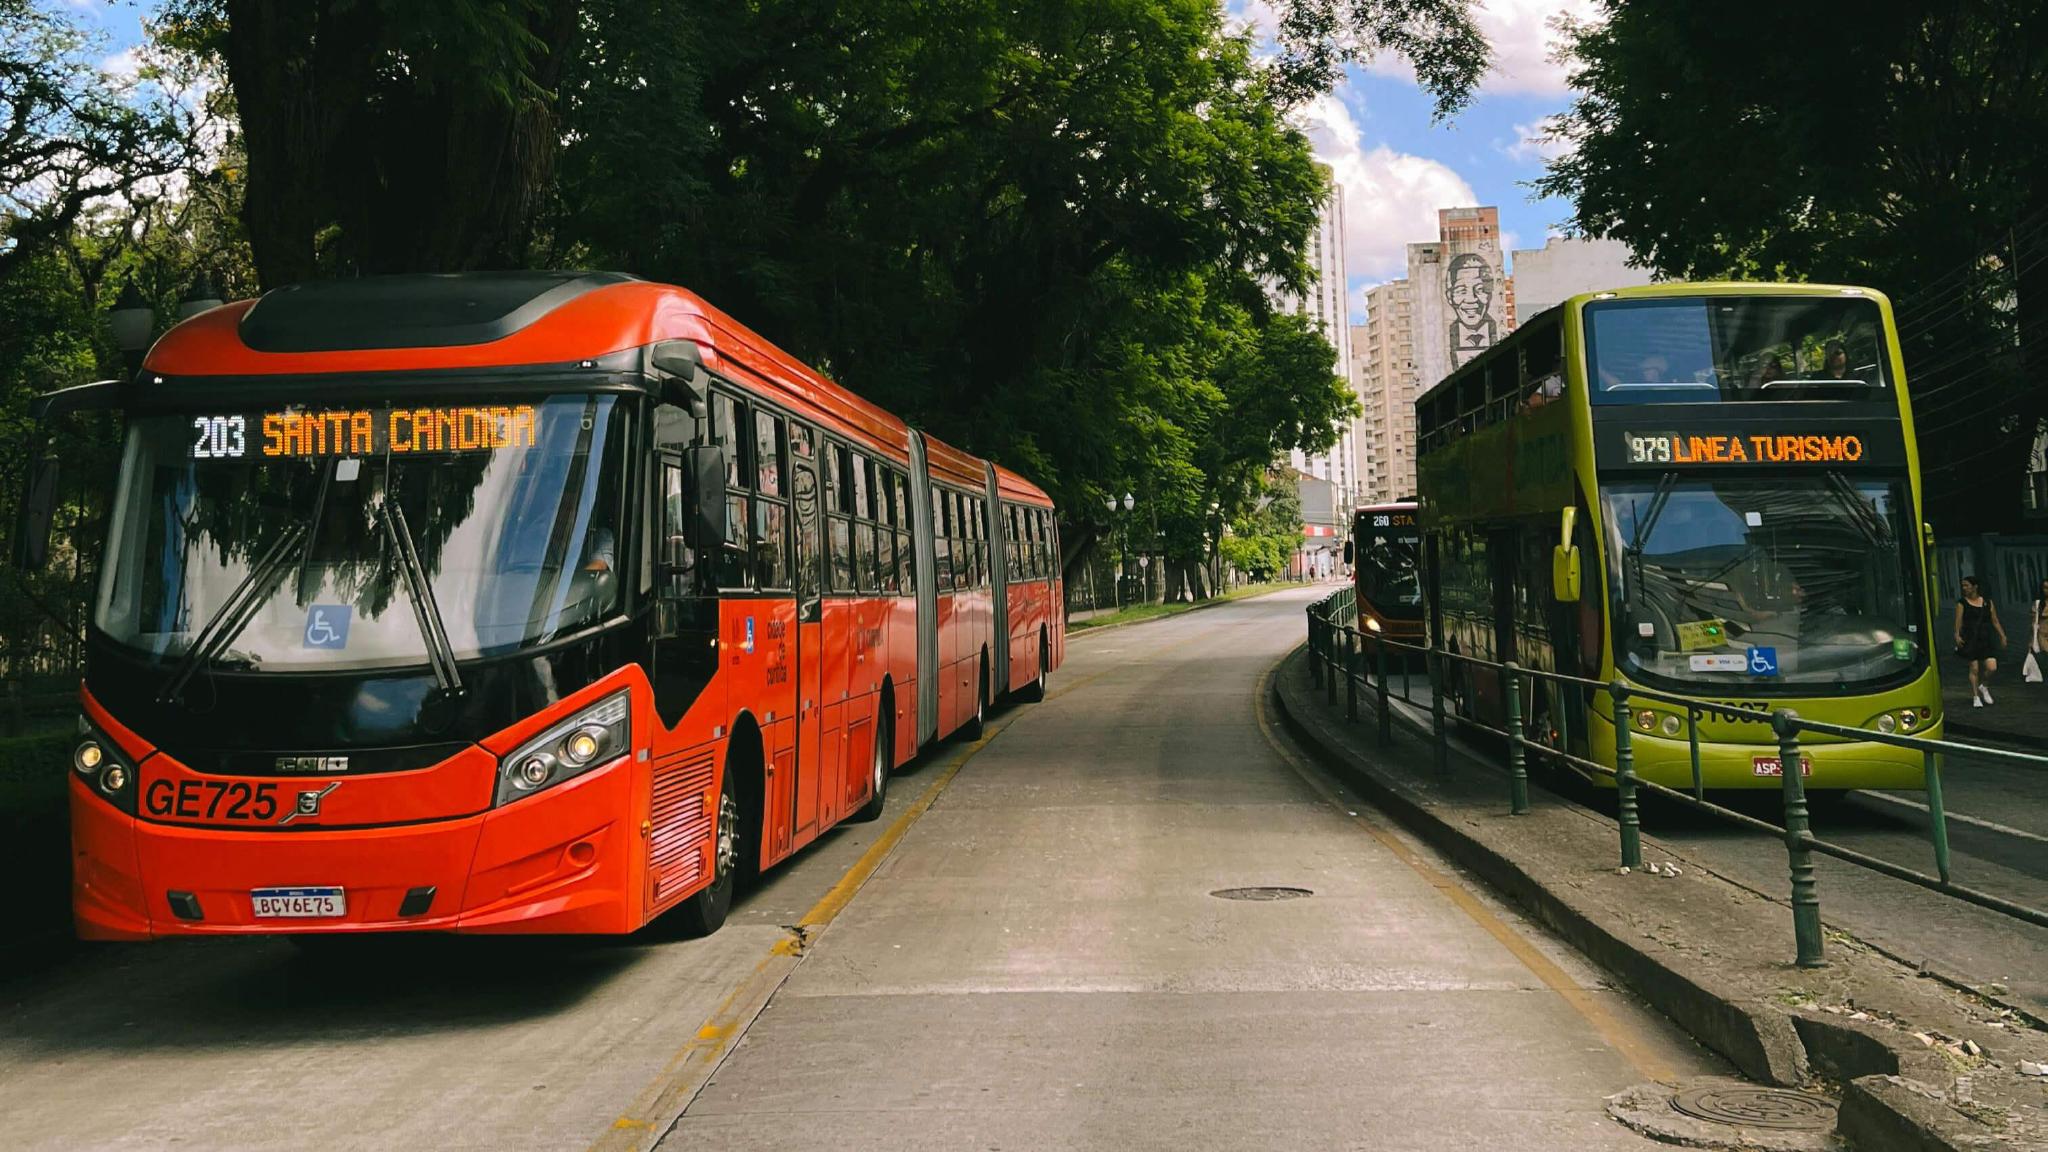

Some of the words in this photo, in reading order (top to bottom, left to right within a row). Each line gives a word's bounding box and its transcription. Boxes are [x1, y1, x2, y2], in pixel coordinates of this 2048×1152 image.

[194, 415, 246, 457] 203
[263, 411, 372, 456] SANTA
[390, 405, 536, 452] CANDIDA
[1632, 437, 1670, 462] 979
[1673, 435, 1748, 463] LINEA
[1750, 435, 1863, 462] TURISMO
[1373, 515, 1390, 527] 260
[145, 778, 277, 821] GE725
[260, 897, 335, 914] BCY6E75
